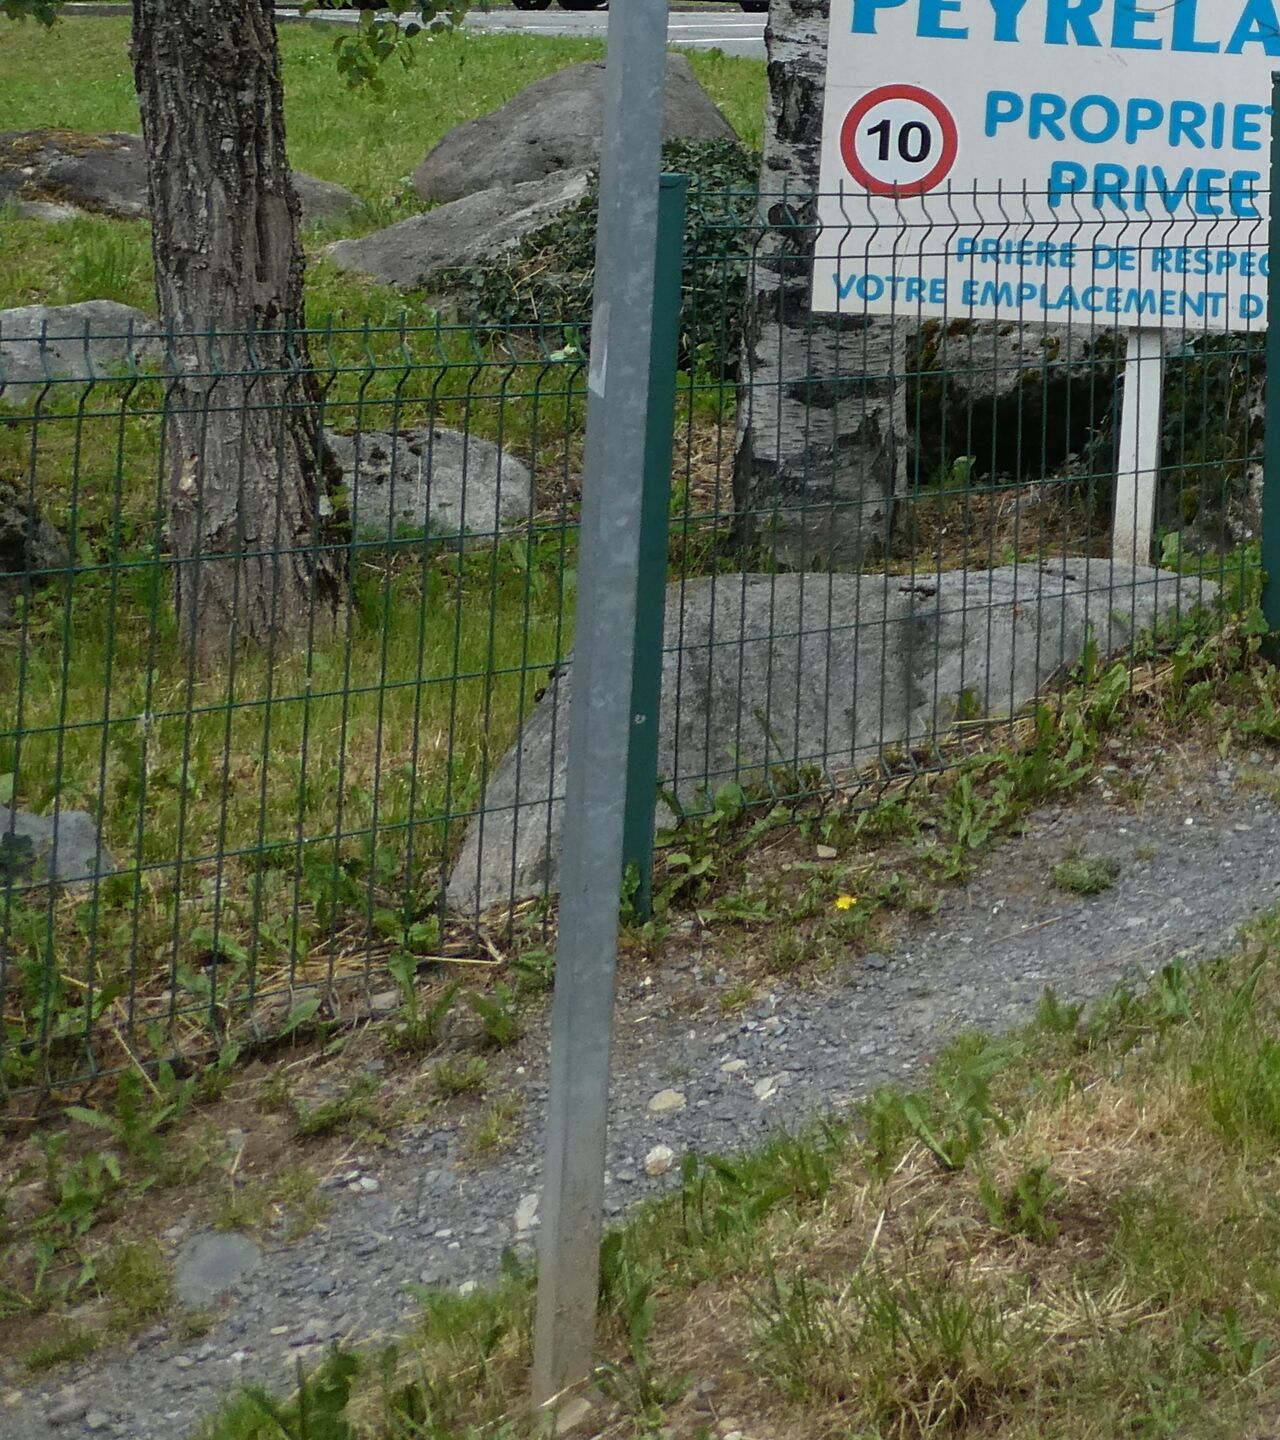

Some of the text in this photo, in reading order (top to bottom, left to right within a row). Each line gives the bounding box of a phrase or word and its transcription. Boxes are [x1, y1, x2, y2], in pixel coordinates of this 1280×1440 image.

[866, 118, 932, 163] 10
[1050, 161, 1262, 218] PRIVEE
[956, 237, 1078, 269] PRIERE
[1092, 244, 1136, 271] DE
[832, 272, 946, 305] VOTRE
[961, 279, 1226, 318] EMPLACEMENT
[1238, 293, 1264, 320] D
